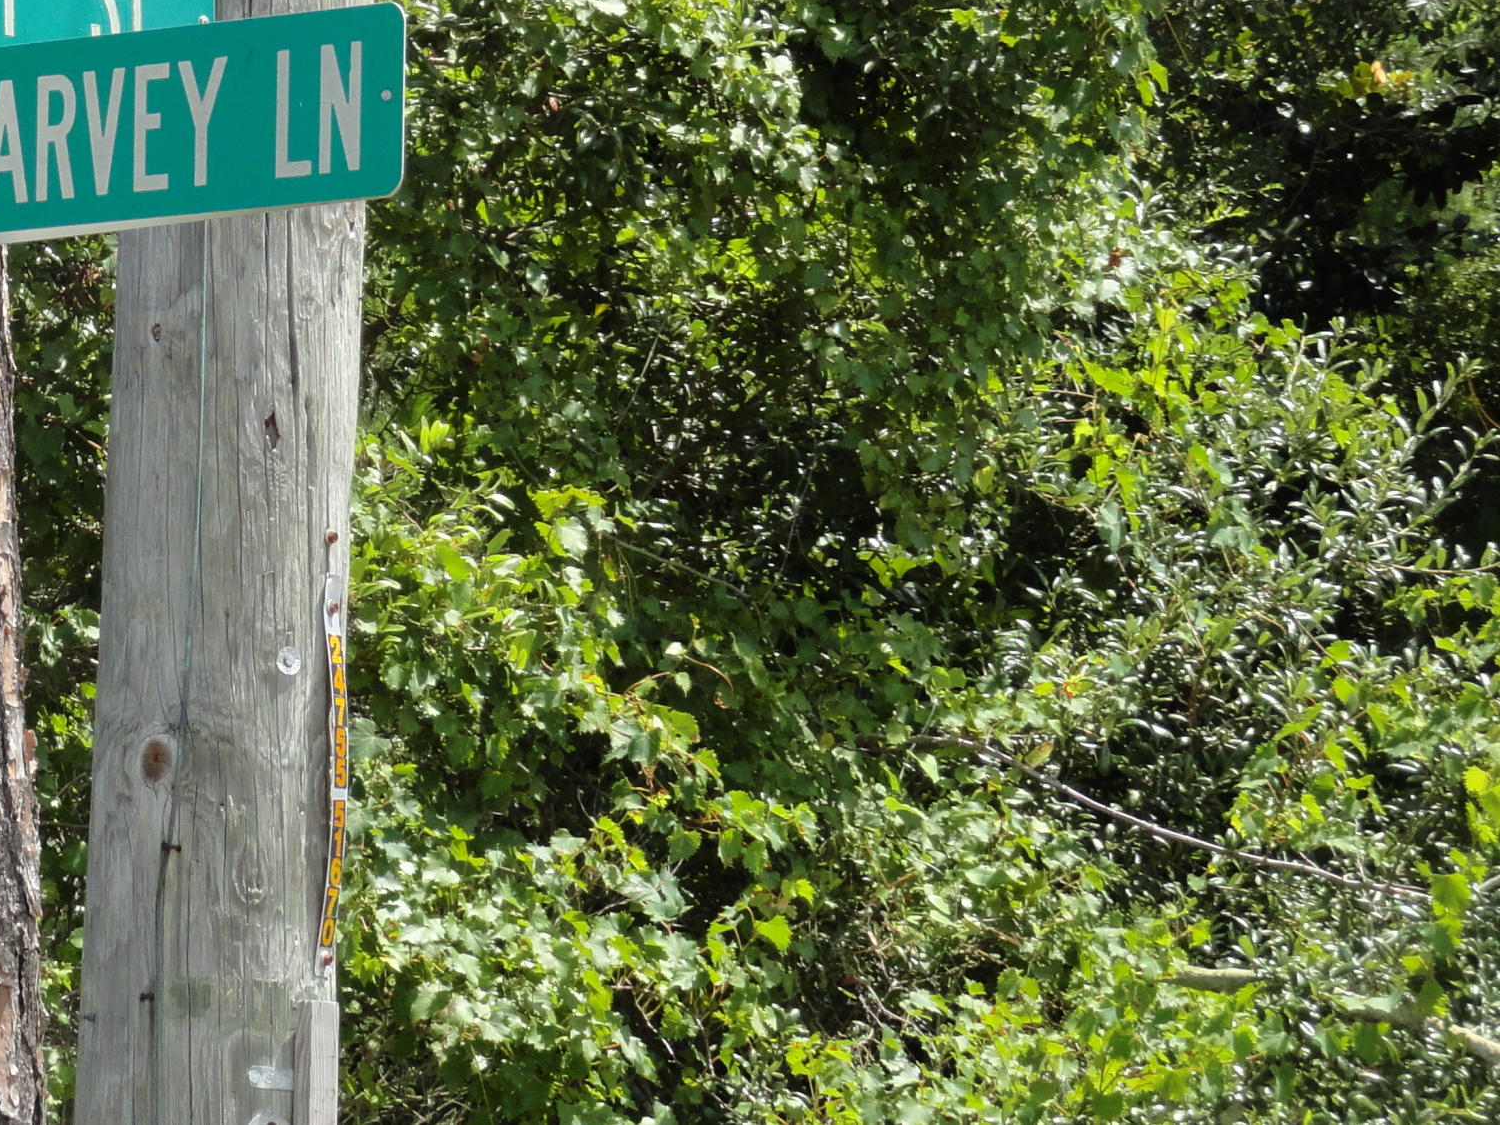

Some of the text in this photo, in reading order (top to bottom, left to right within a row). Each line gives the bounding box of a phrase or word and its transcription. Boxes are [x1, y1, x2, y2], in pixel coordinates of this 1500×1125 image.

[275, 40, 363, 179] LN
[321, 634, 348, 947] 24755 51670
